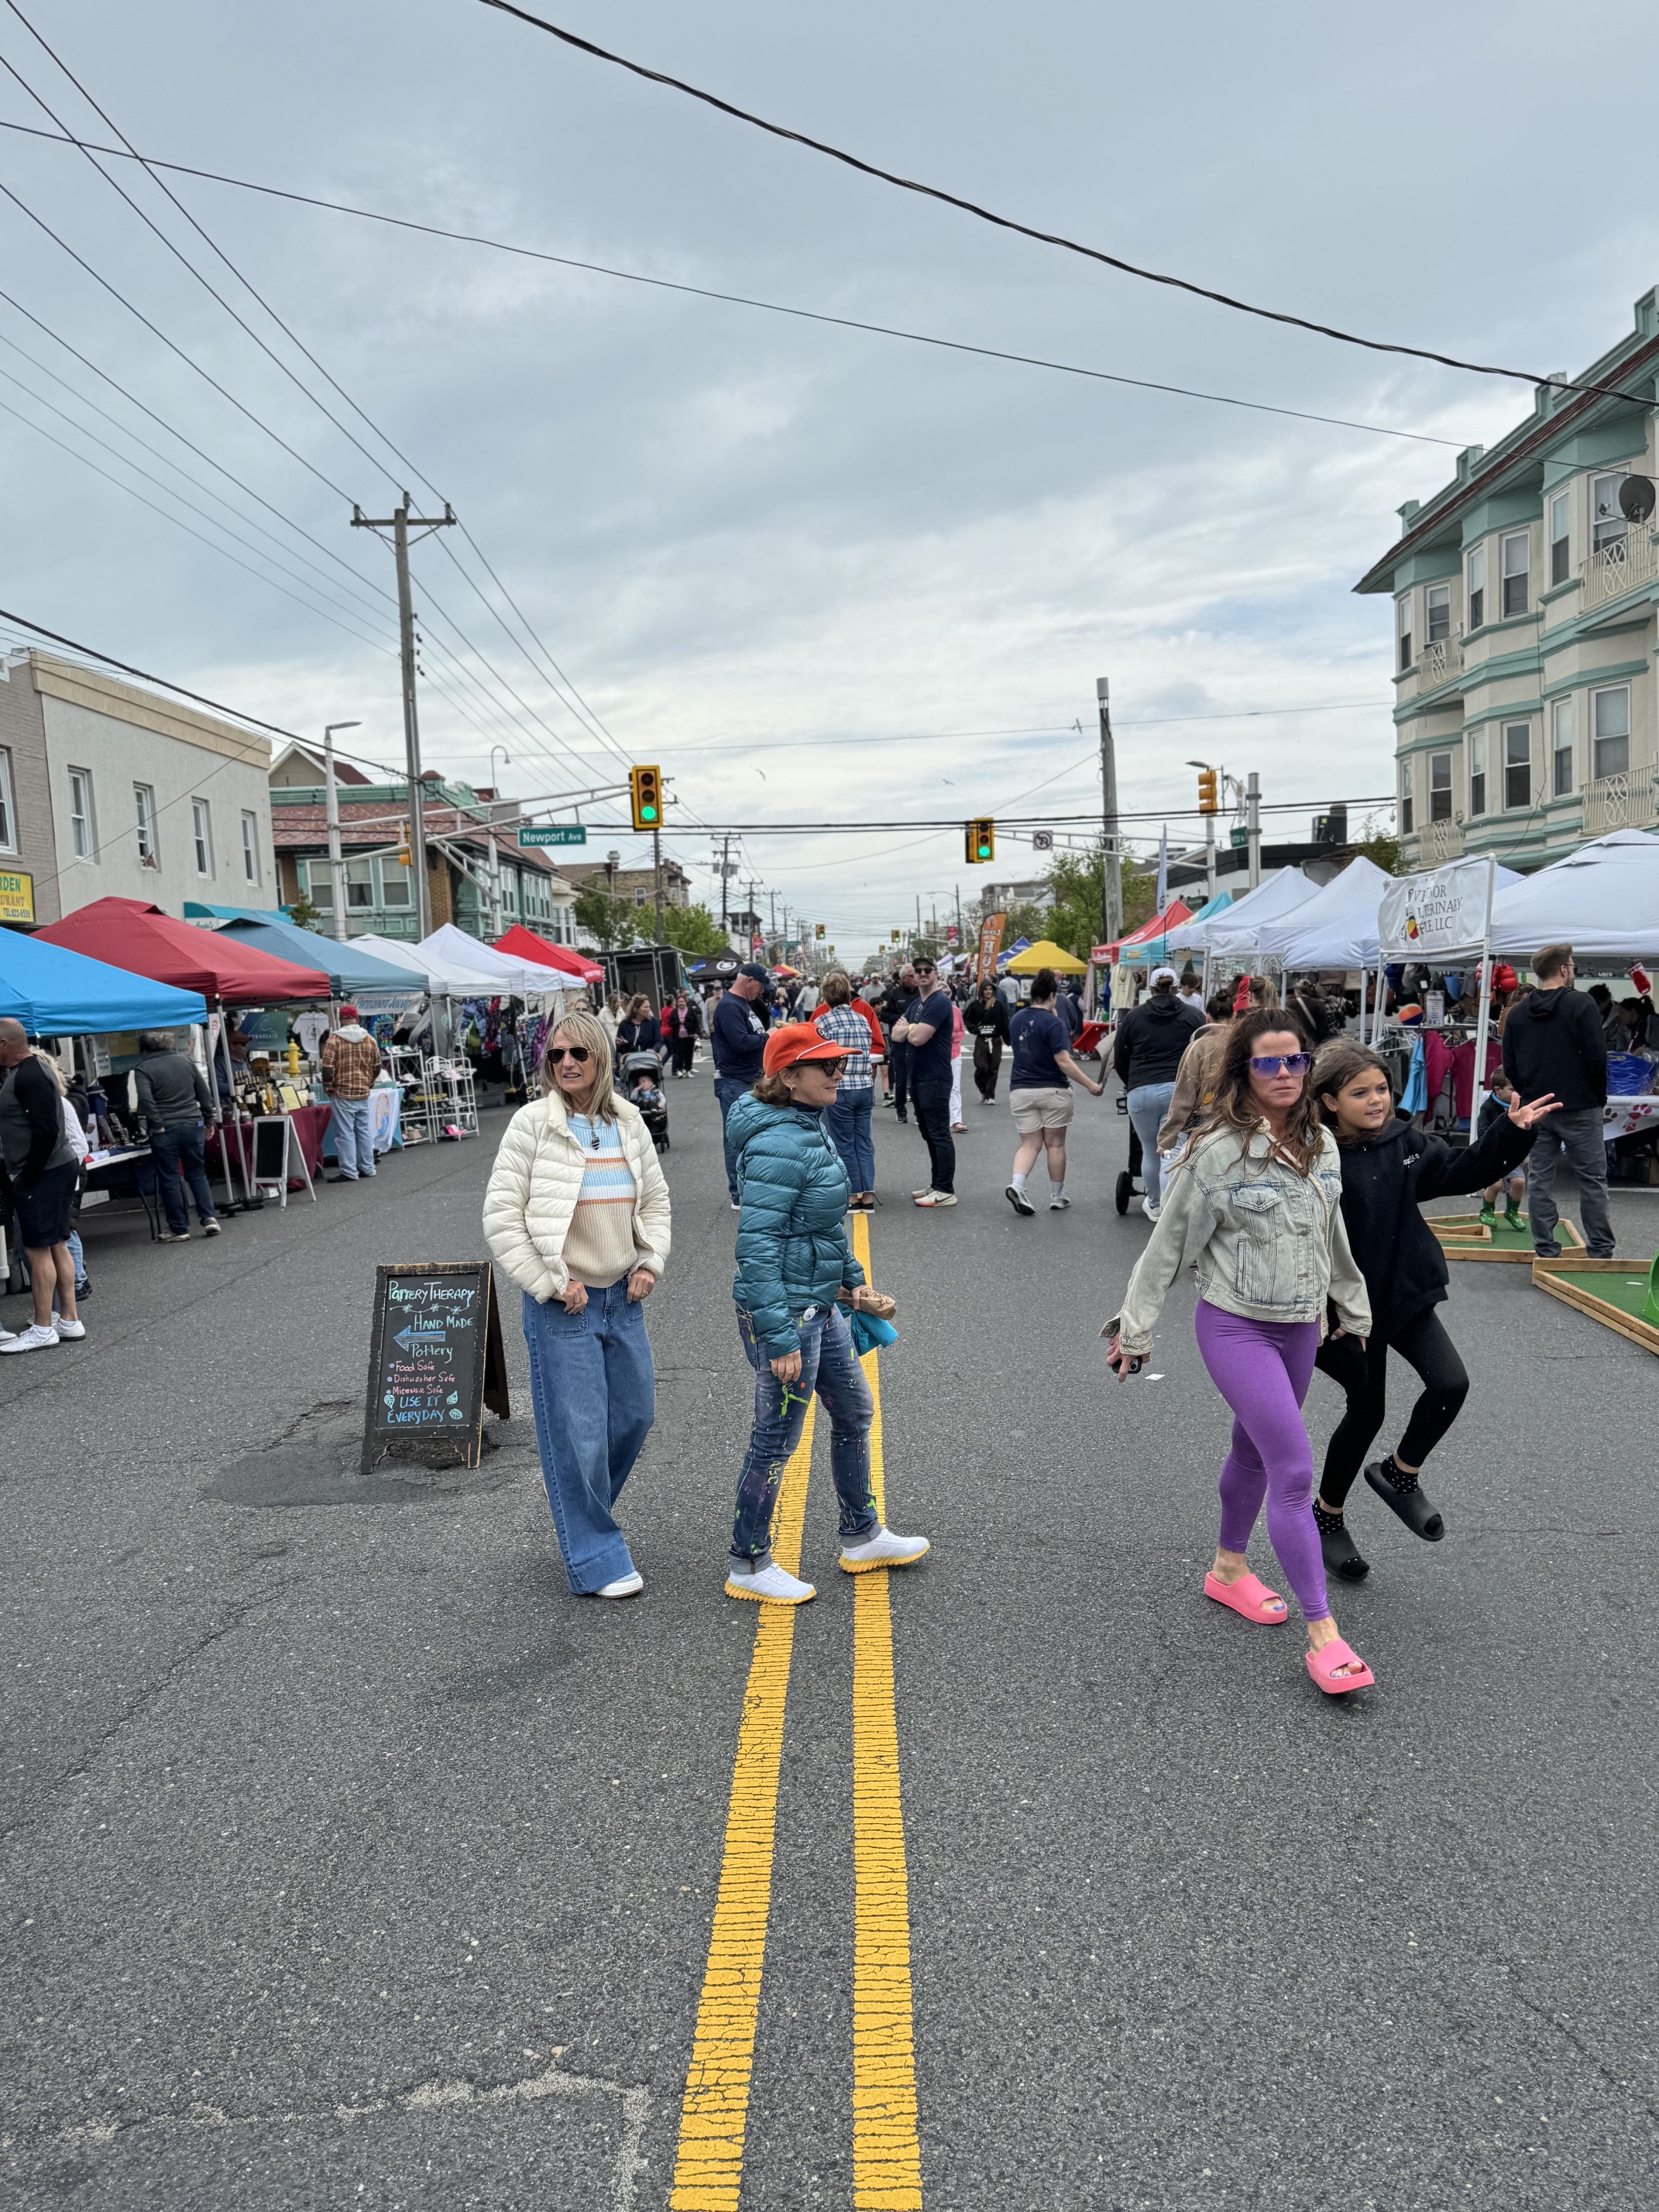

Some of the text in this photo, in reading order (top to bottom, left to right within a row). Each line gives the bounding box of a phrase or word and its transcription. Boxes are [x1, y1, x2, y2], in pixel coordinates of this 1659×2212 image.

[523, 831, 582, 844] Newport Ave
[1434, 915, 1453, 931] LLC
[414, 1314, 444, 1331] HAND
[410, 1343, 454, 1364] Pottery
[395, 1359, 434, 1372] Food Safe
[393, 1371, 455, 1383] Dishwasher Safe
[427, 1383, 444, 1394] Safe
[400, 1395, 441, 1409] USE IT
[387, 1409, 445, 1424] EVERYDAY
